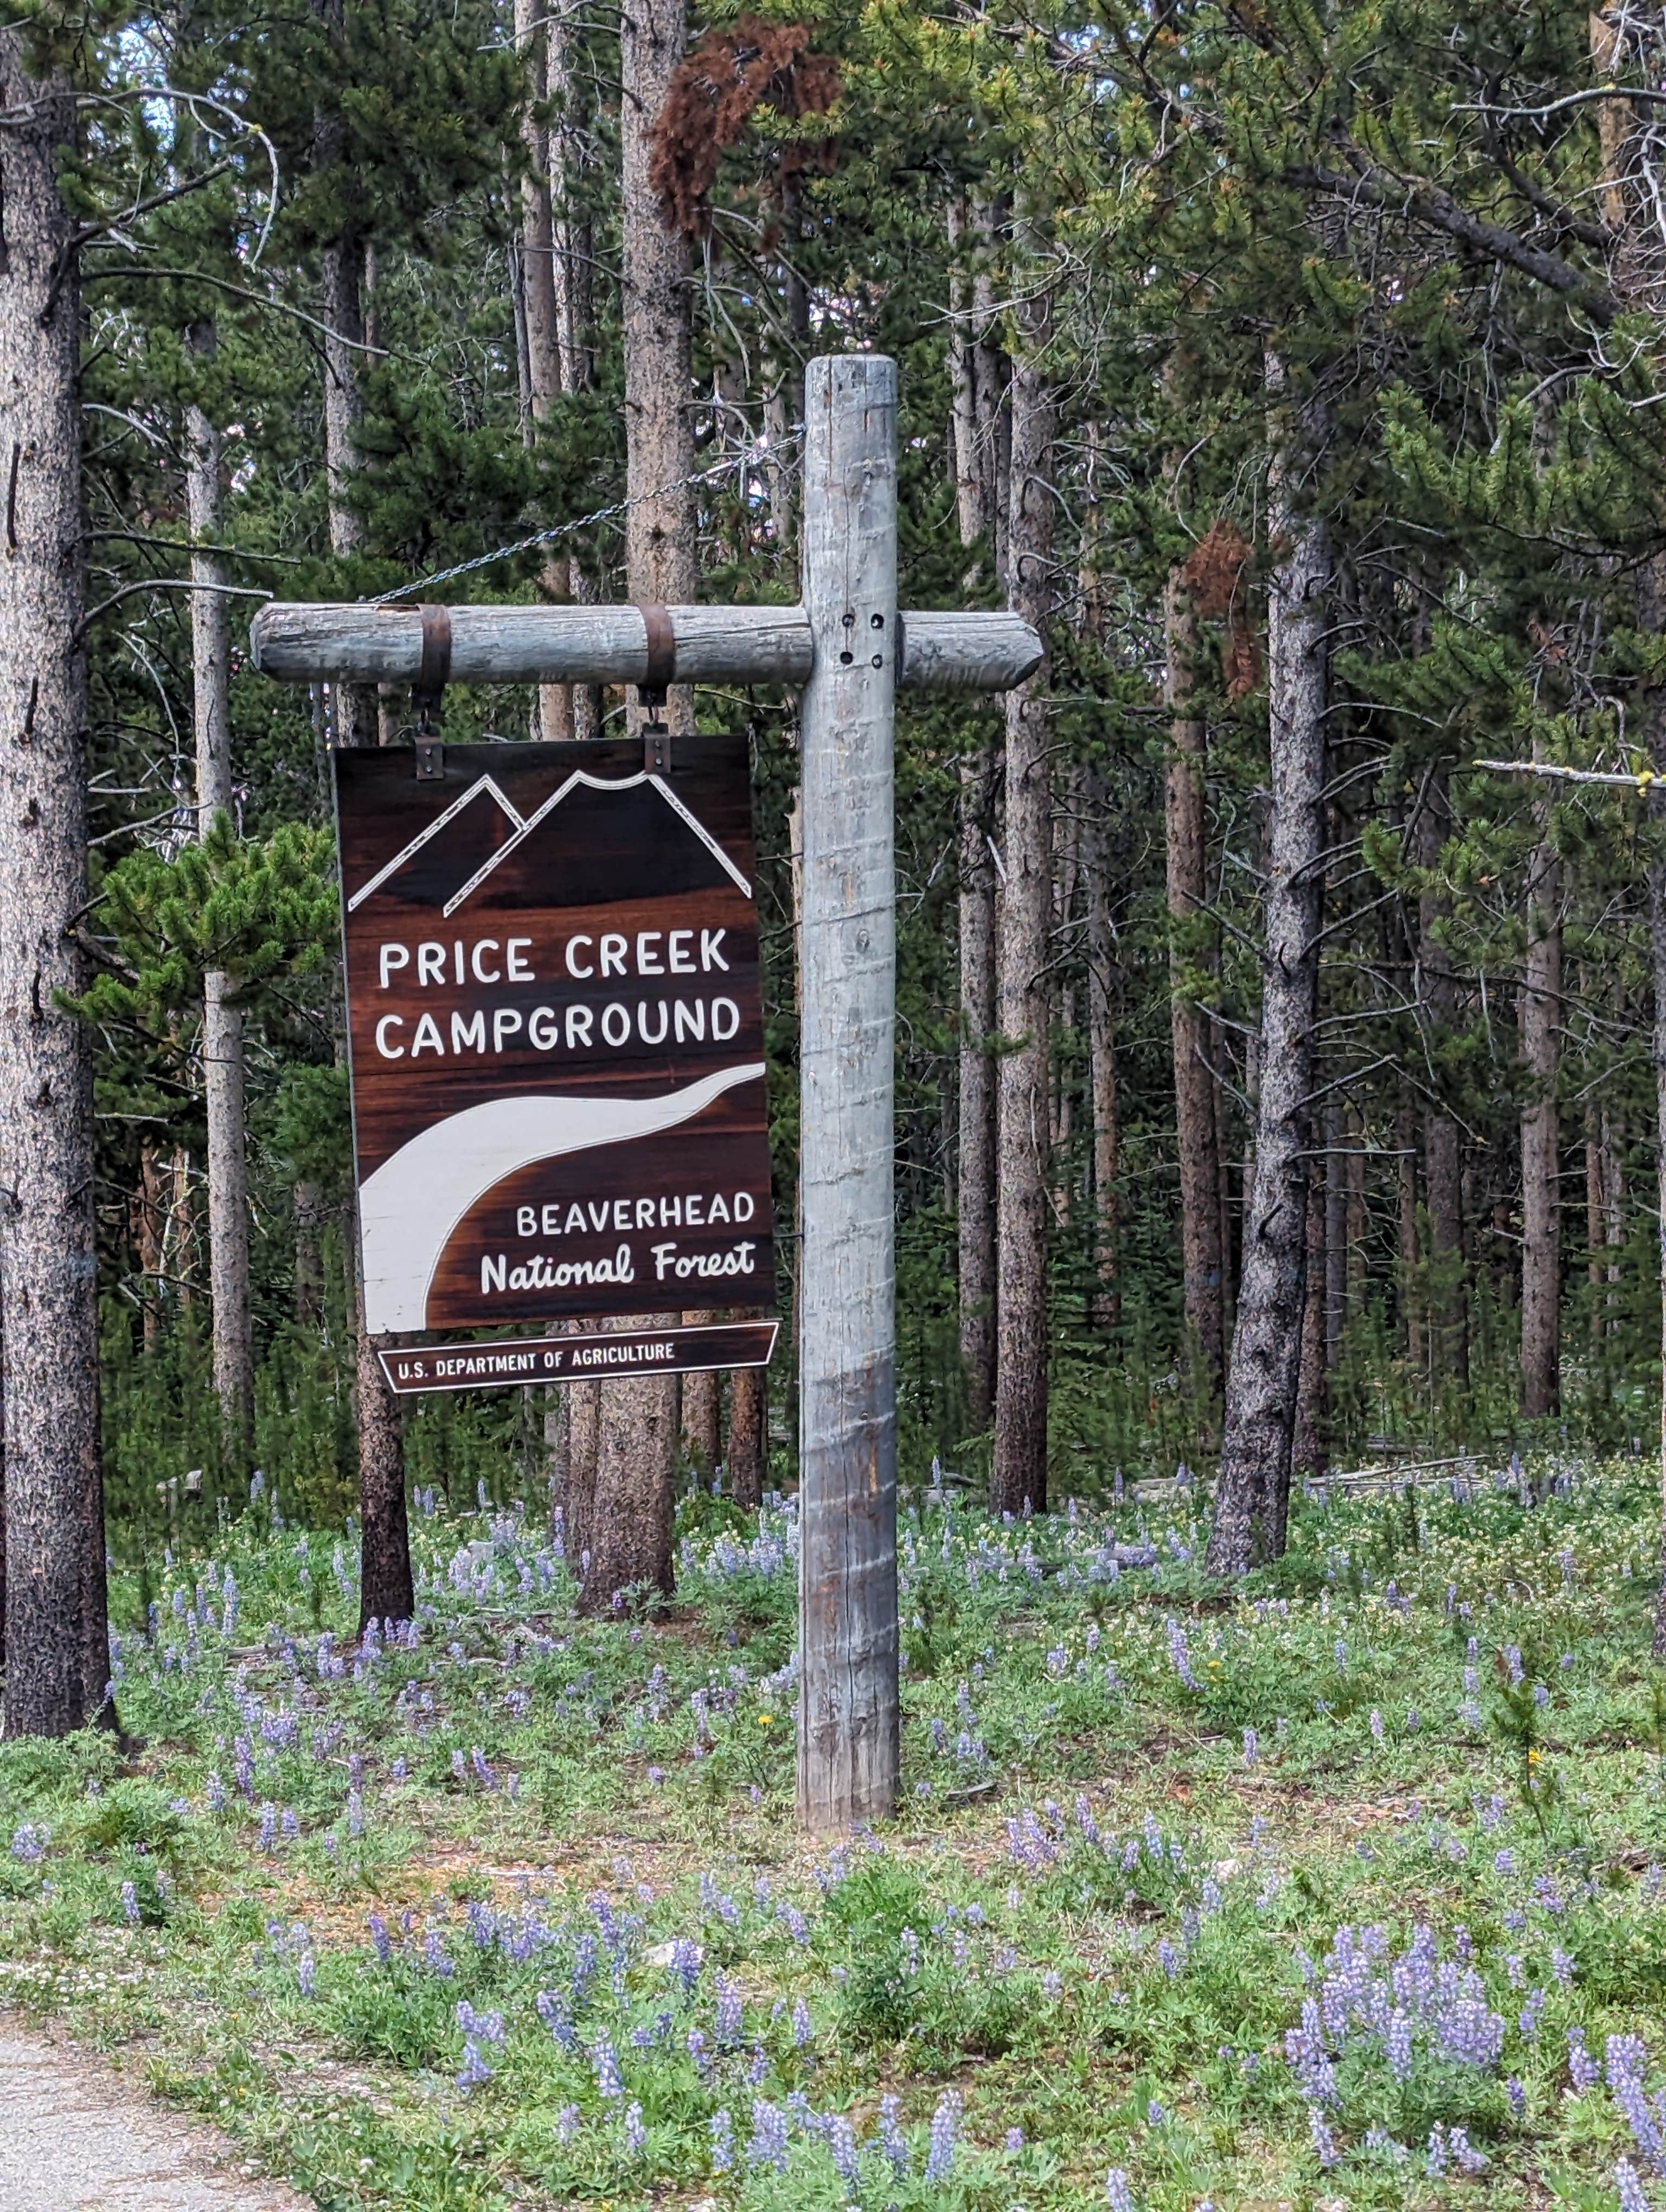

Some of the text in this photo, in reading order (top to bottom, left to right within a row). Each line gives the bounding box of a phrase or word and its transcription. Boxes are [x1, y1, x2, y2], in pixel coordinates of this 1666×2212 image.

[379, 928, 729, 989] PRICE CREEK
[375, 997, 740, 1059] CAMPGROUND
[517, 1192, 754, 1237] BEAVERHEAD
[481, 1242, 756, 1294] National Forest
[398, 1342, 675, 1380] U.S. DEPARTMENT OF AGRICULTURE
